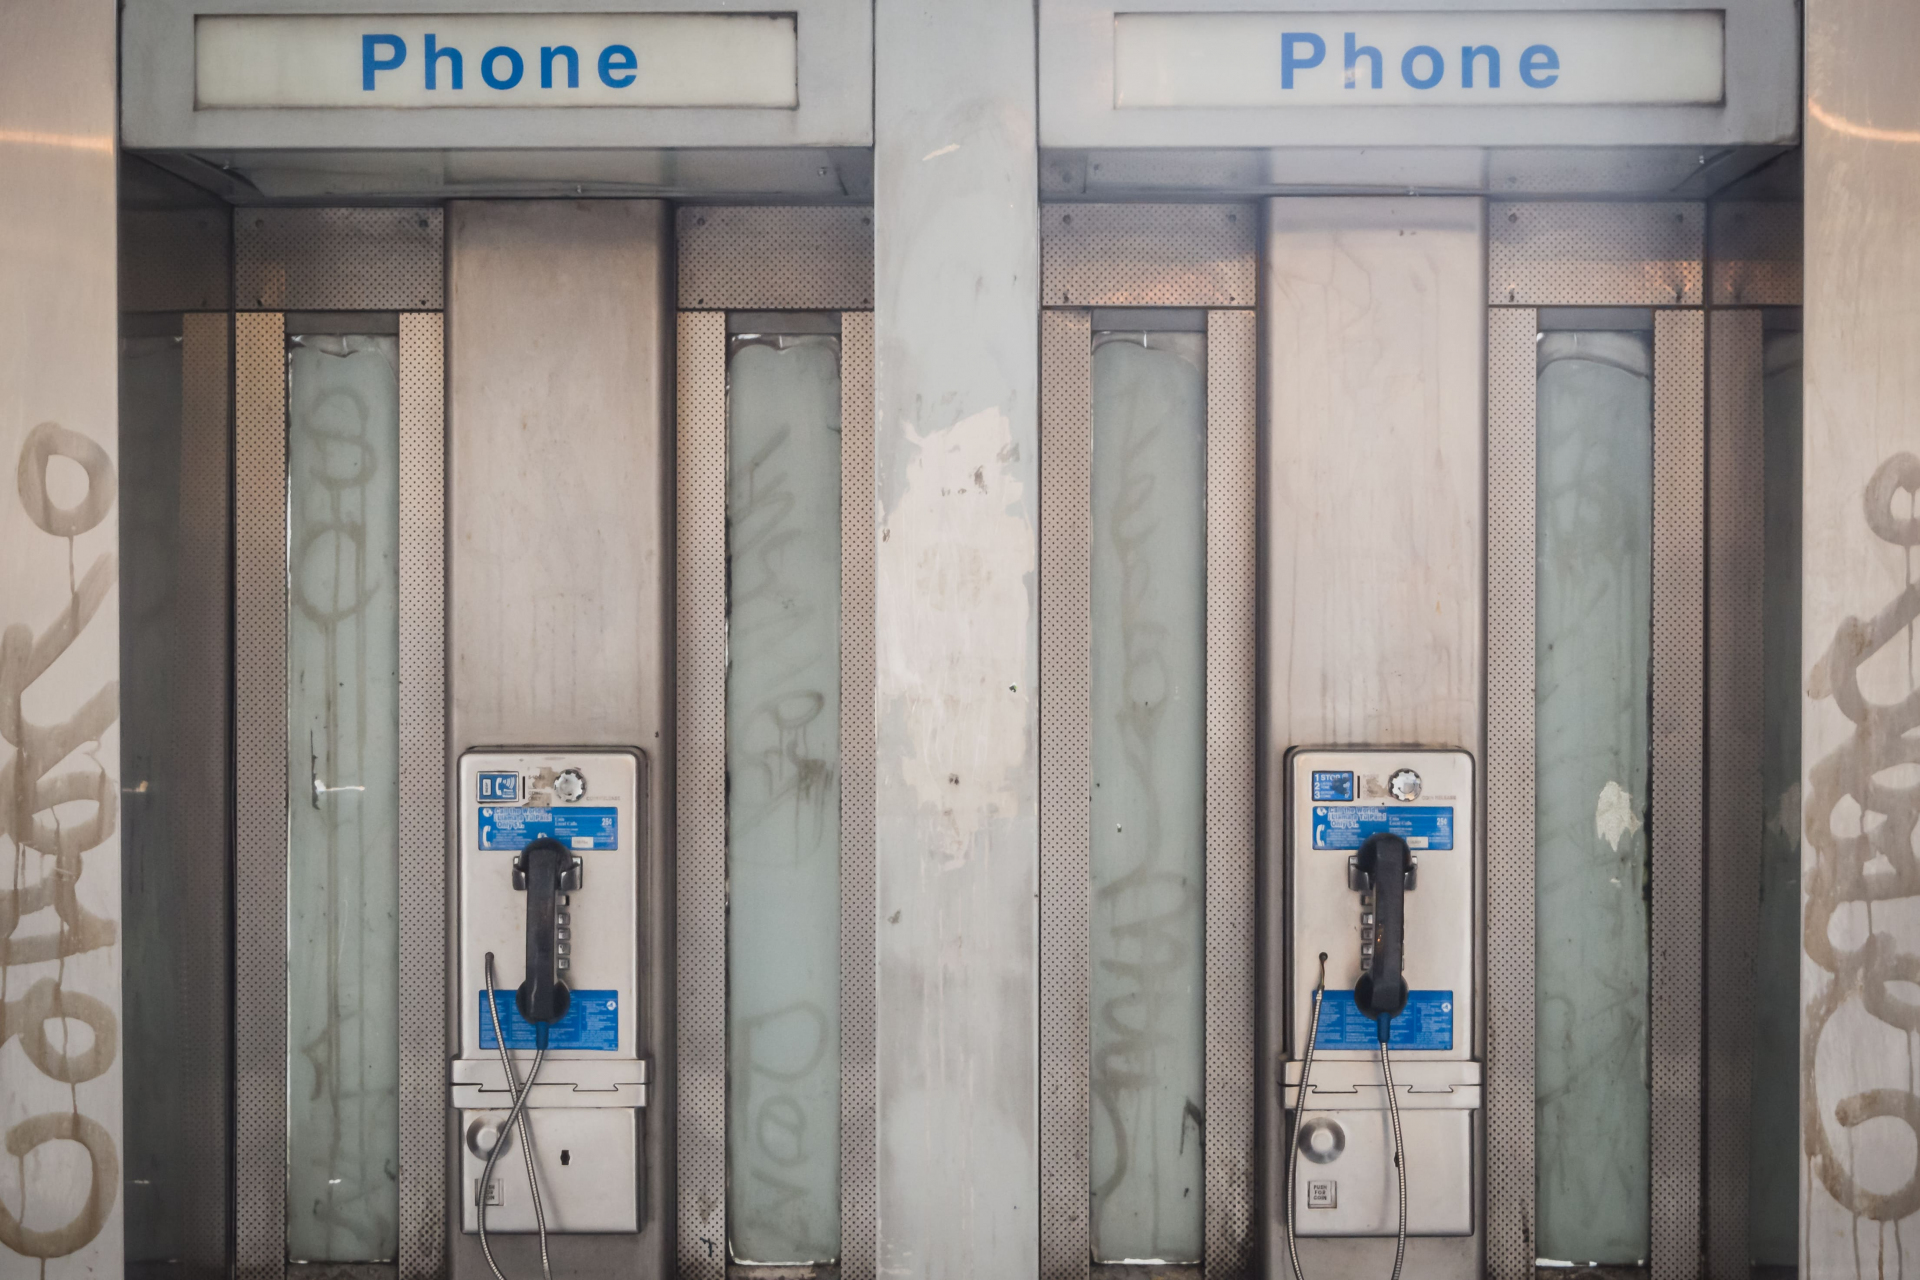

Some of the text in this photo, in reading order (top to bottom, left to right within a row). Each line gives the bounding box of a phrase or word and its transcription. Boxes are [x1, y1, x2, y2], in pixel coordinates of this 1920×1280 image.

[361, 33, 639, 92] Phone
[1280, 31, 1561, 91] Phone
[1314, 791, 1320, 799] 3
[496, 821, 512, 829] Only
[602, 817, 612, 826] 25¢
[1331, 820, 1346, 828] Only
[1437, 817, 1447, 826] 25¢
